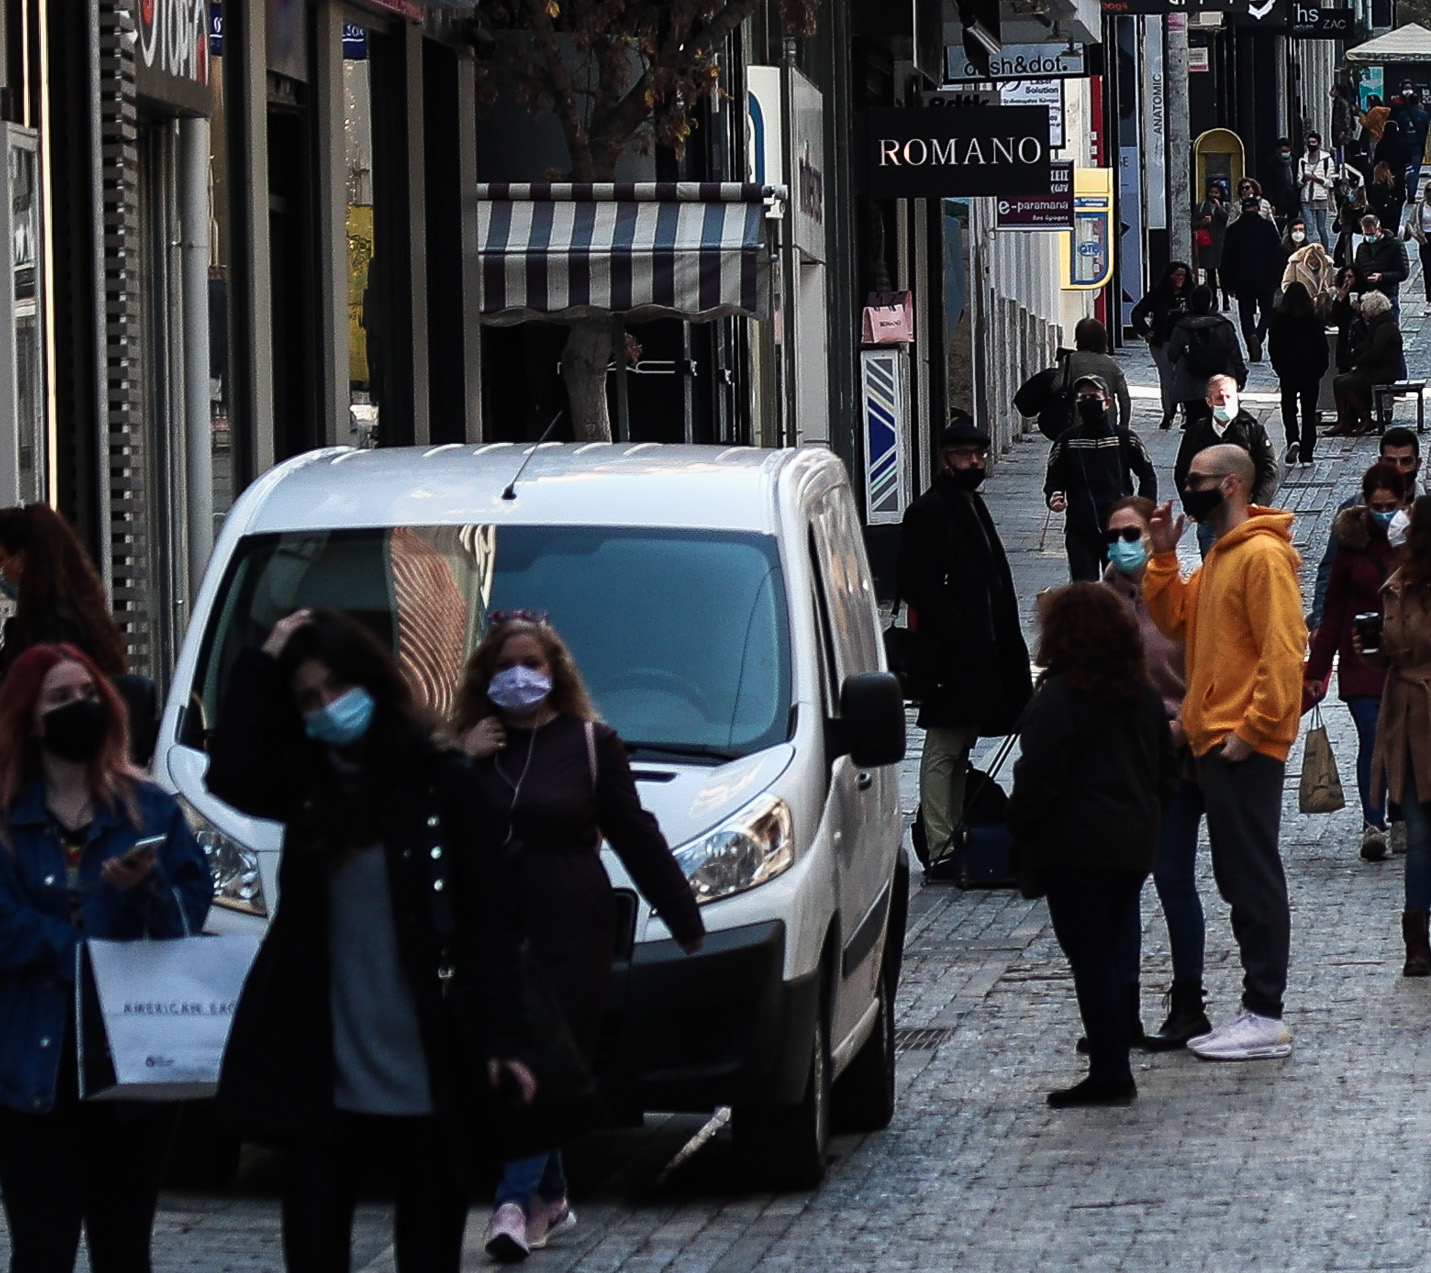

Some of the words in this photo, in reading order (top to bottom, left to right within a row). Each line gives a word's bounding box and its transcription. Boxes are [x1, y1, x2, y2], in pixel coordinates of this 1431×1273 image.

[1025, 86, 1059, 95] Solution
[1153, 73, 1163, 135] ANATOMIC
[878, 136, 1042, 166] ROMANO
